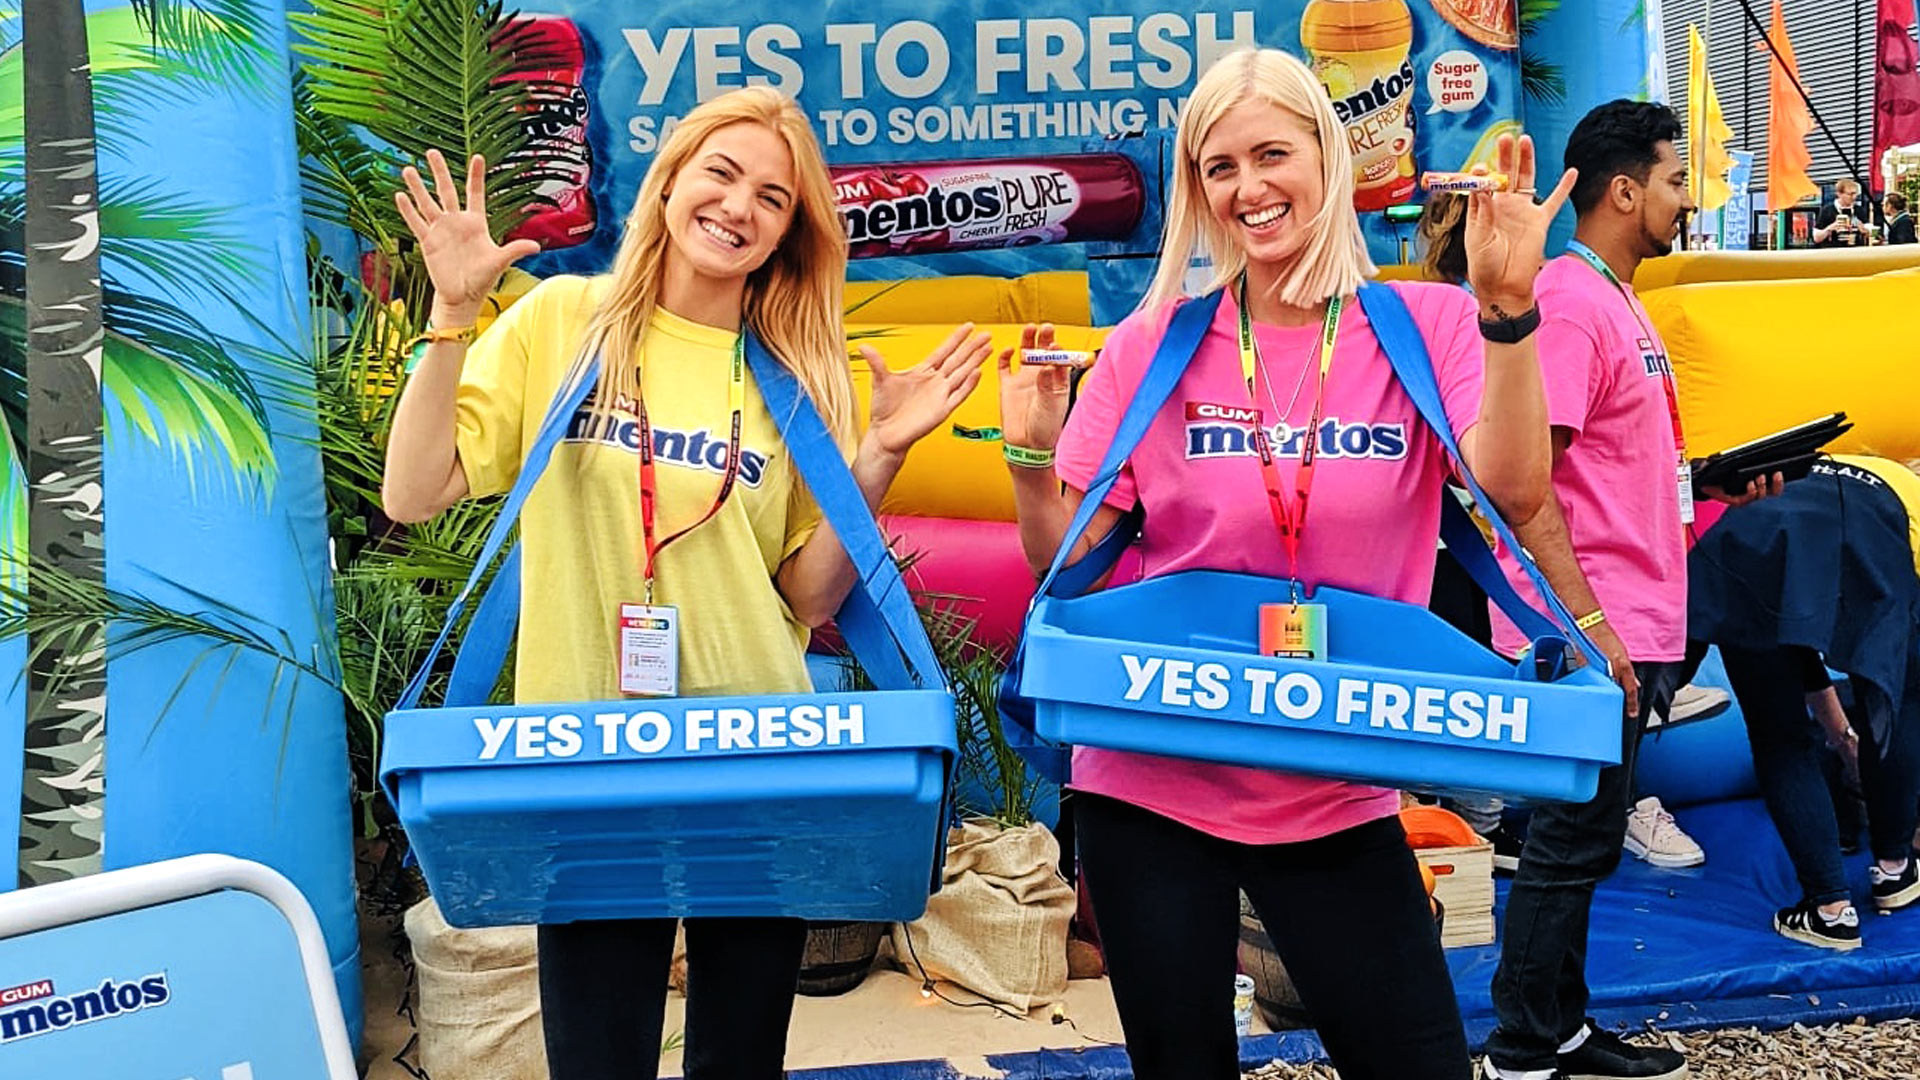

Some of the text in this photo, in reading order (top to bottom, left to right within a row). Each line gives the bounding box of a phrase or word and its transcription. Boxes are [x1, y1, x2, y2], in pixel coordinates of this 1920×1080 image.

[622, 11, 1254, 105] YES TO FRESH
[1434, 62, 1480, 77] Sugar
[1332, 61, 1414, 124] entos
[1441, 78, 1473, 89] free
[1441, 91, 1474, 104] gum
[819, 108, 877, 145] TO
[888, 99, 1148, 143] SOMETHING
[1001, 171, 1073, 214] PURE
[1430, 180, 1478, 191] mentos
[958, 225, 1002, 240] CHERRY
[1003, 208, 1048, 233] FRESH
[1196, 405, 1256, 420] GUM
[565, 410, 766, 485] mentos
[1120, 654, 1529, 744] YES TO FRESH
[474, 704, 866, 760] YES TO FRESH
[0, 976, 168, 1039] mentos
[1, 982, 52, 1003] GUM
